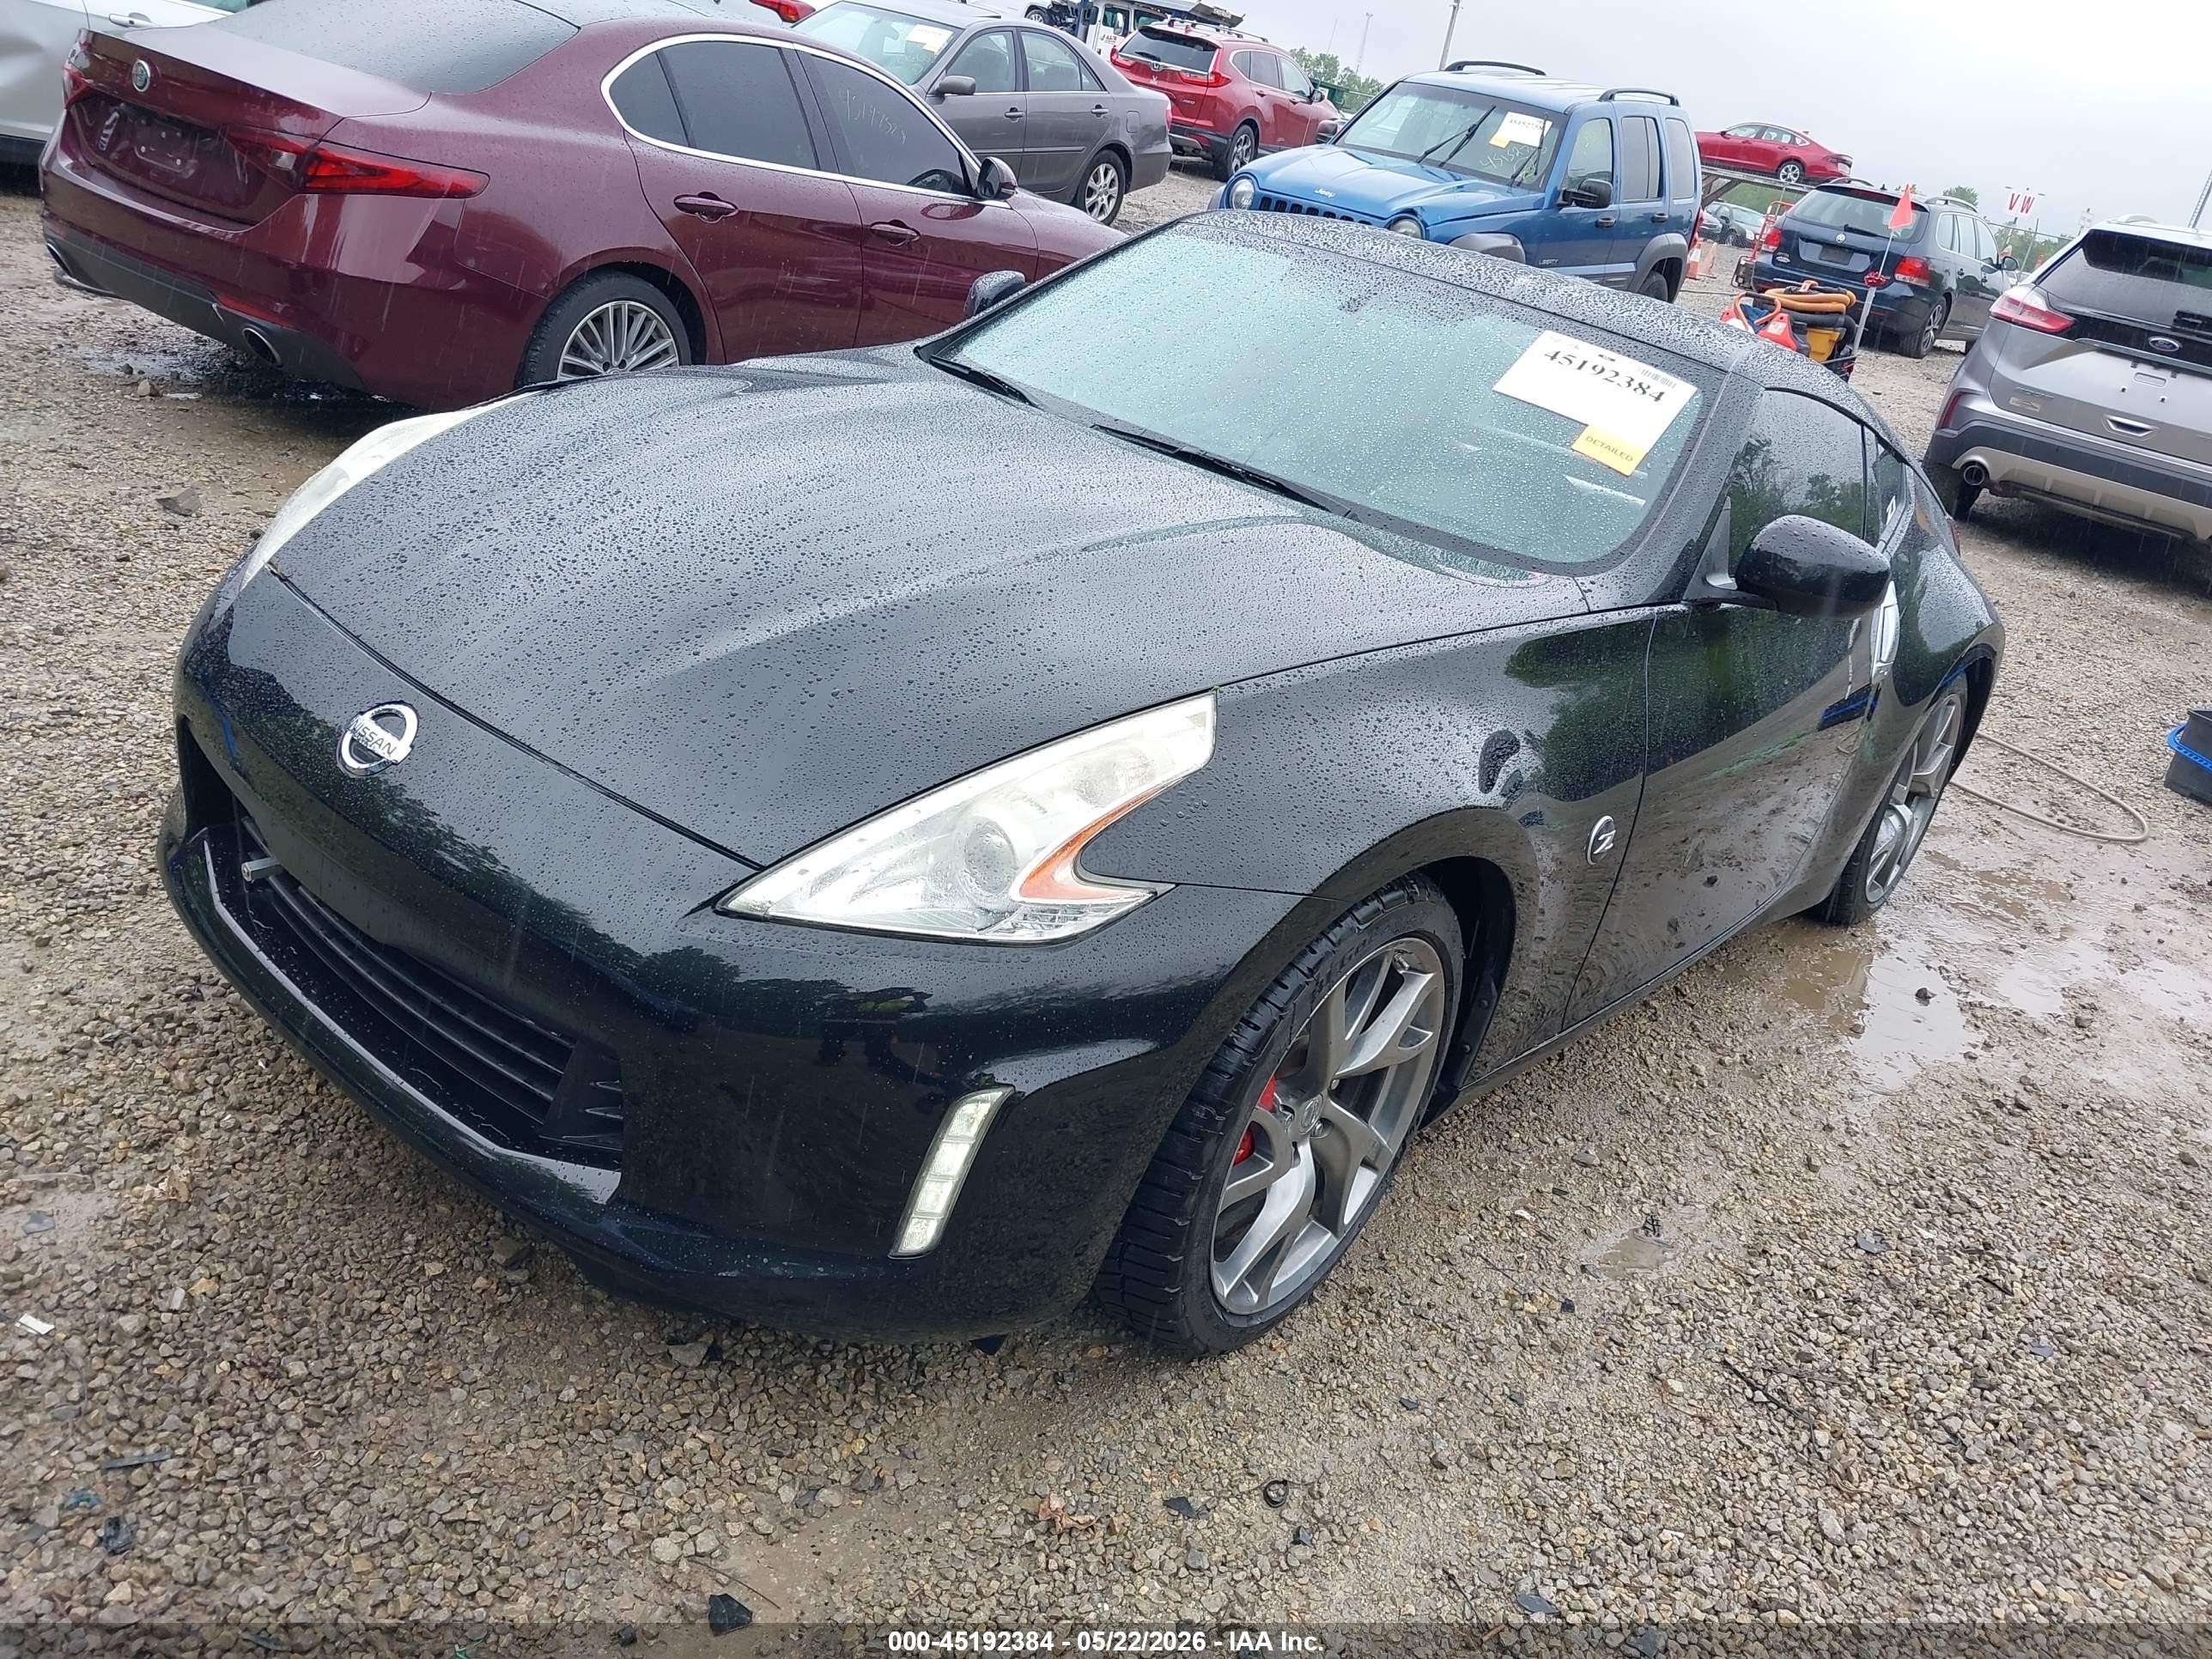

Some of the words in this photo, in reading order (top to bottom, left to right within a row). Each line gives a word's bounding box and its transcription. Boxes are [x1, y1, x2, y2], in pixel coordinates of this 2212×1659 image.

[1544, 349, 1666, 403] 45192384
[1585, 434, 1634, 463] DETAILED
[349, 717, 398, 756] NISSAN
